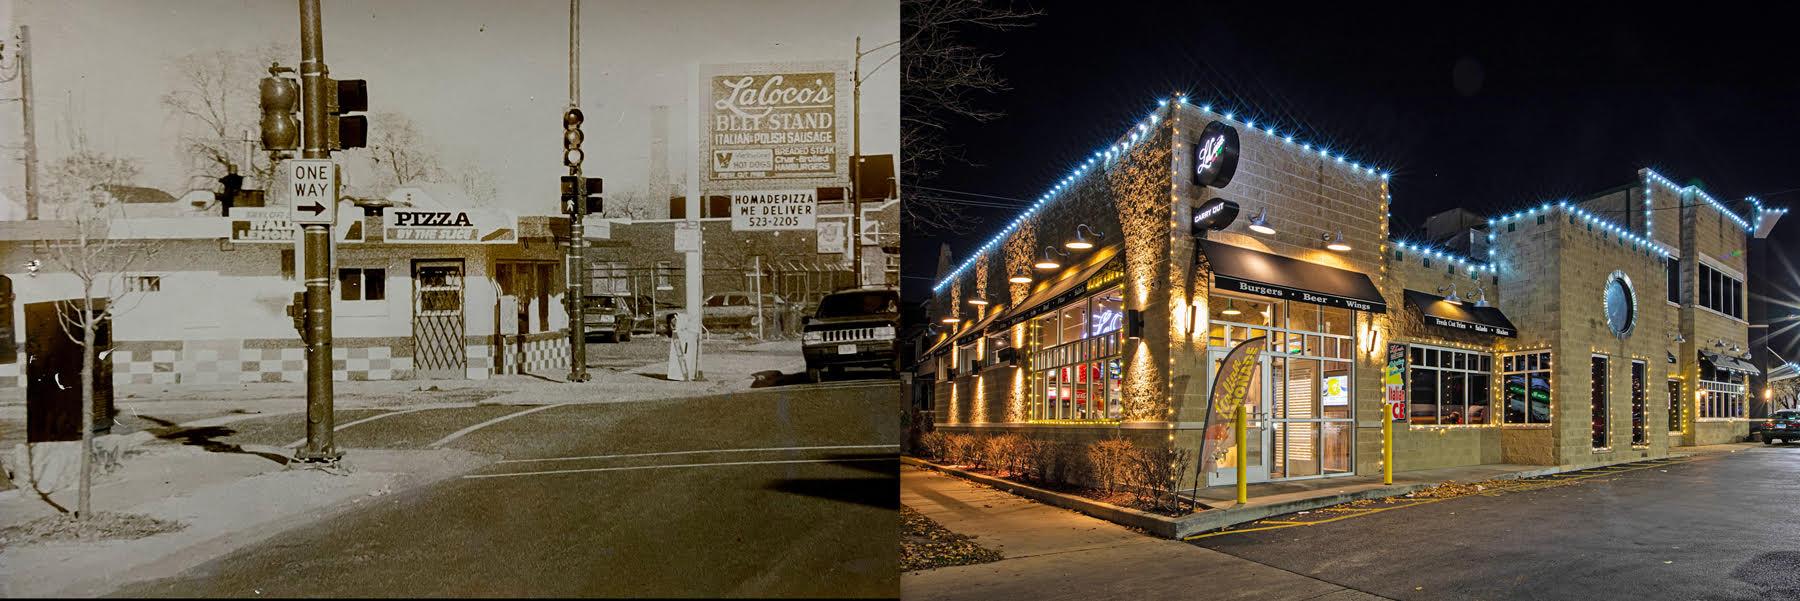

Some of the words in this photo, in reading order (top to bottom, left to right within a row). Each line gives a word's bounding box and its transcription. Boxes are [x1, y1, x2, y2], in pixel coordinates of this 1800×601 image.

[715, 75, 834, 117] LaCoco's
[716, 113, 762, 131] BEEF
[769, 112, 833, 130] STAND
[714, 133, 750, 146] ITALIAN
[754, 132, 785, 144] POLISH
[786, 131, 833, 143] SAUSAGE
[775, 148, 809, 156] BREADED
[810, 146, 835, 155] STEAK
[733, 161, 747, 169] HOT
[749, 160, 771, 169] DOGS
[775, 163, 830, 172] HAMBURGERS
[295, 166, 328, 180] ONE
[295, 184, 328, 197] WAY
[735, 194, 814, 205] HOMADEPIZZA
[741, 206, 756, 216] WE
[763, 205, 812, 215] DELIVER
[1194, 209, 1212, 223] CARRY
[1212, 202, 1225, 214] OUT
[394, 211, 473, 227] PIZZA
[749, 217, 799, 227] 523-2205
[397, 228, 412, 240] BY
[414, 228, 437, 240] THE
[438, 228, 471, 240] SLICE
[1239, 282, 1283, 297] Burgers
[1302, 292, 1328, 305] Beer
[1346, 300, 1371, 311] Wings
[1436, 318, 1448, 327] Fresh
[1448, 320, 1456, 328] Cut
[1456, 322, 1466, 330] Fries
